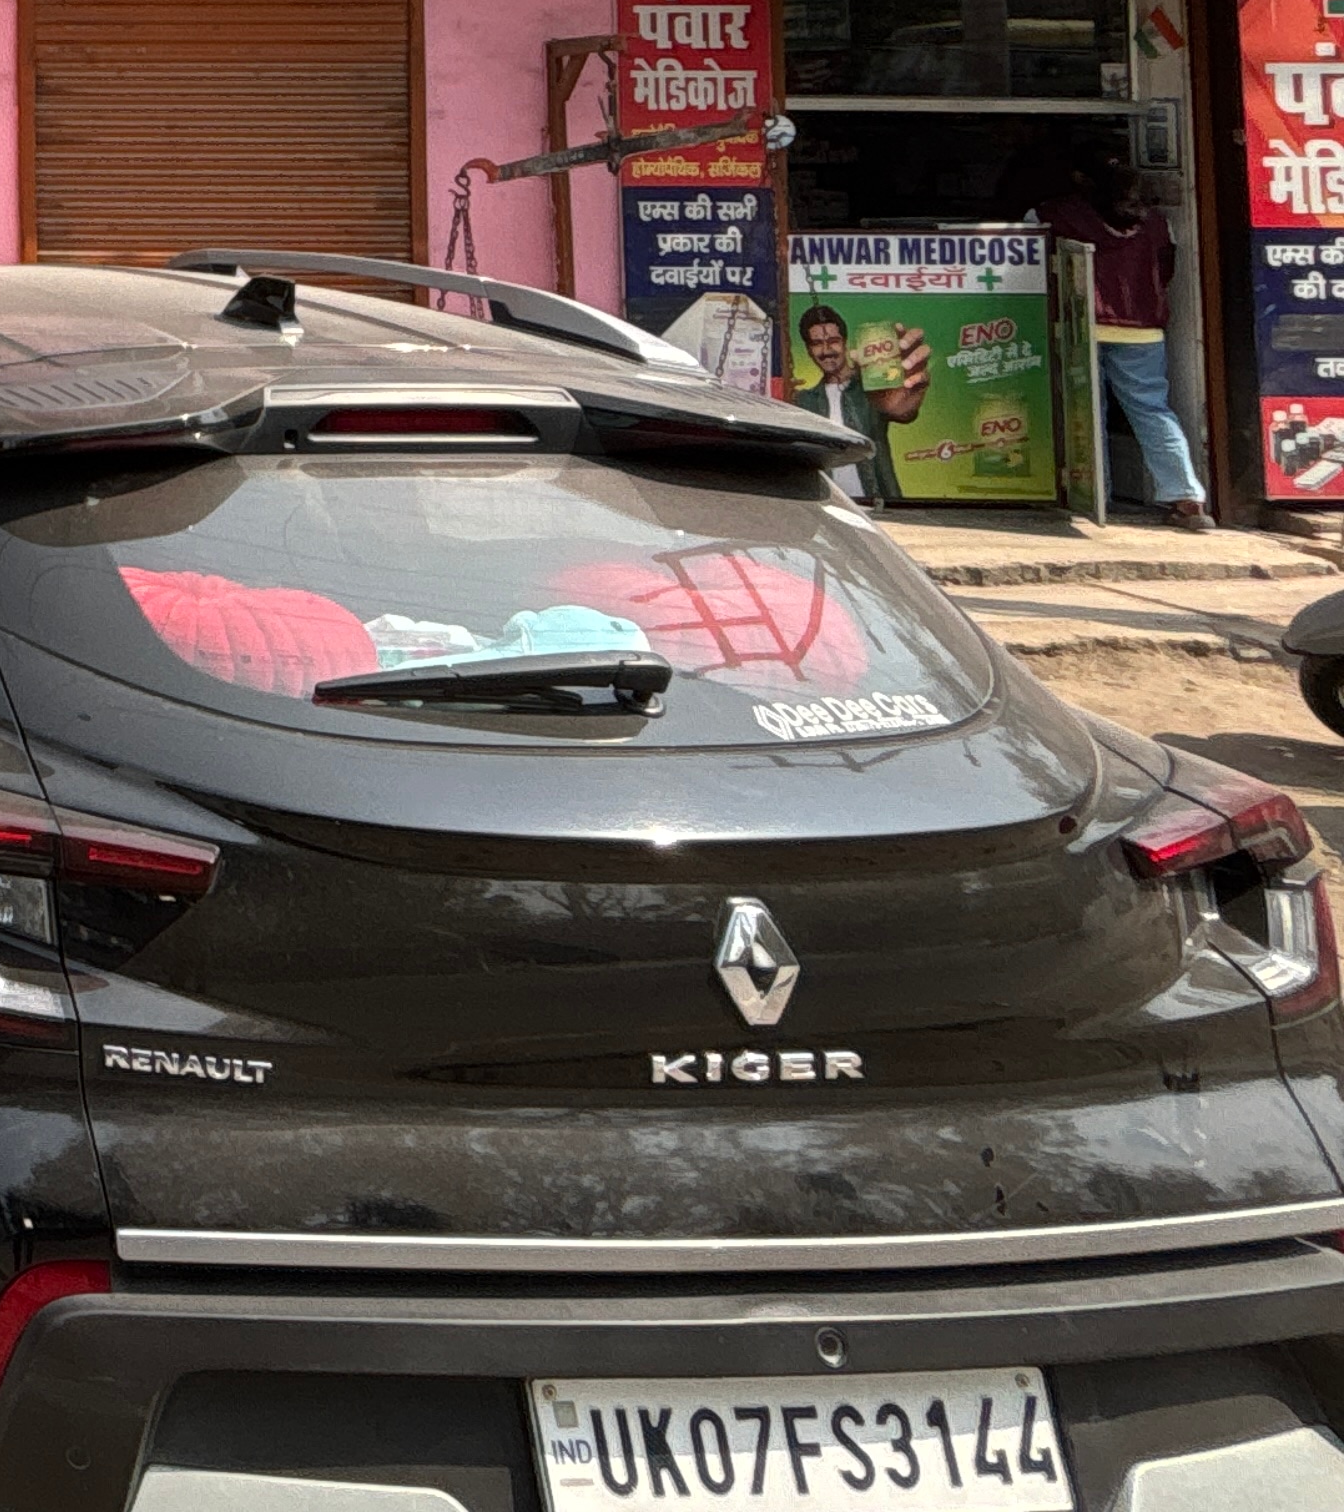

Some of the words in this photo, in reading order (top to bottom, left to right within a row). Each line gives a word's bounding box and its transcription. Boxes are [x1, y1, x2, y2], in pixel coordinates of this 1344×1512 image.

[629, 58, 758, 110] मेडिकोज
[1265, 41, 1344, 125] पं
[638, 200, 680, 221] एम्स
[683, 193, 713, 221] की
[716, 193, 758, 221] सभी
[657, 234, 711, 256] प्रकार
[713, 226, 743, 253] की
[898, 238, 1041, 266] MEDICOSE
[1266, 245, 1315, 266] एम्स
[649, 258, 724, 288] दवाईयों
[846, 266, 967, 291] दवाईयाँ
[1292, 271, 1326, 299] की
[960, 318, 1016, 346] ENO
[863, 340, 894, 357] ENO
[981, 418, 1022, 437] ENO
[104, 1044, 273, 1084] RENAULT
[651, 1051, 865, 1084] KIGER
[551, 1439, 593, 1464] IND
[590, 1394, 1058, 1498] UK07FS3144
